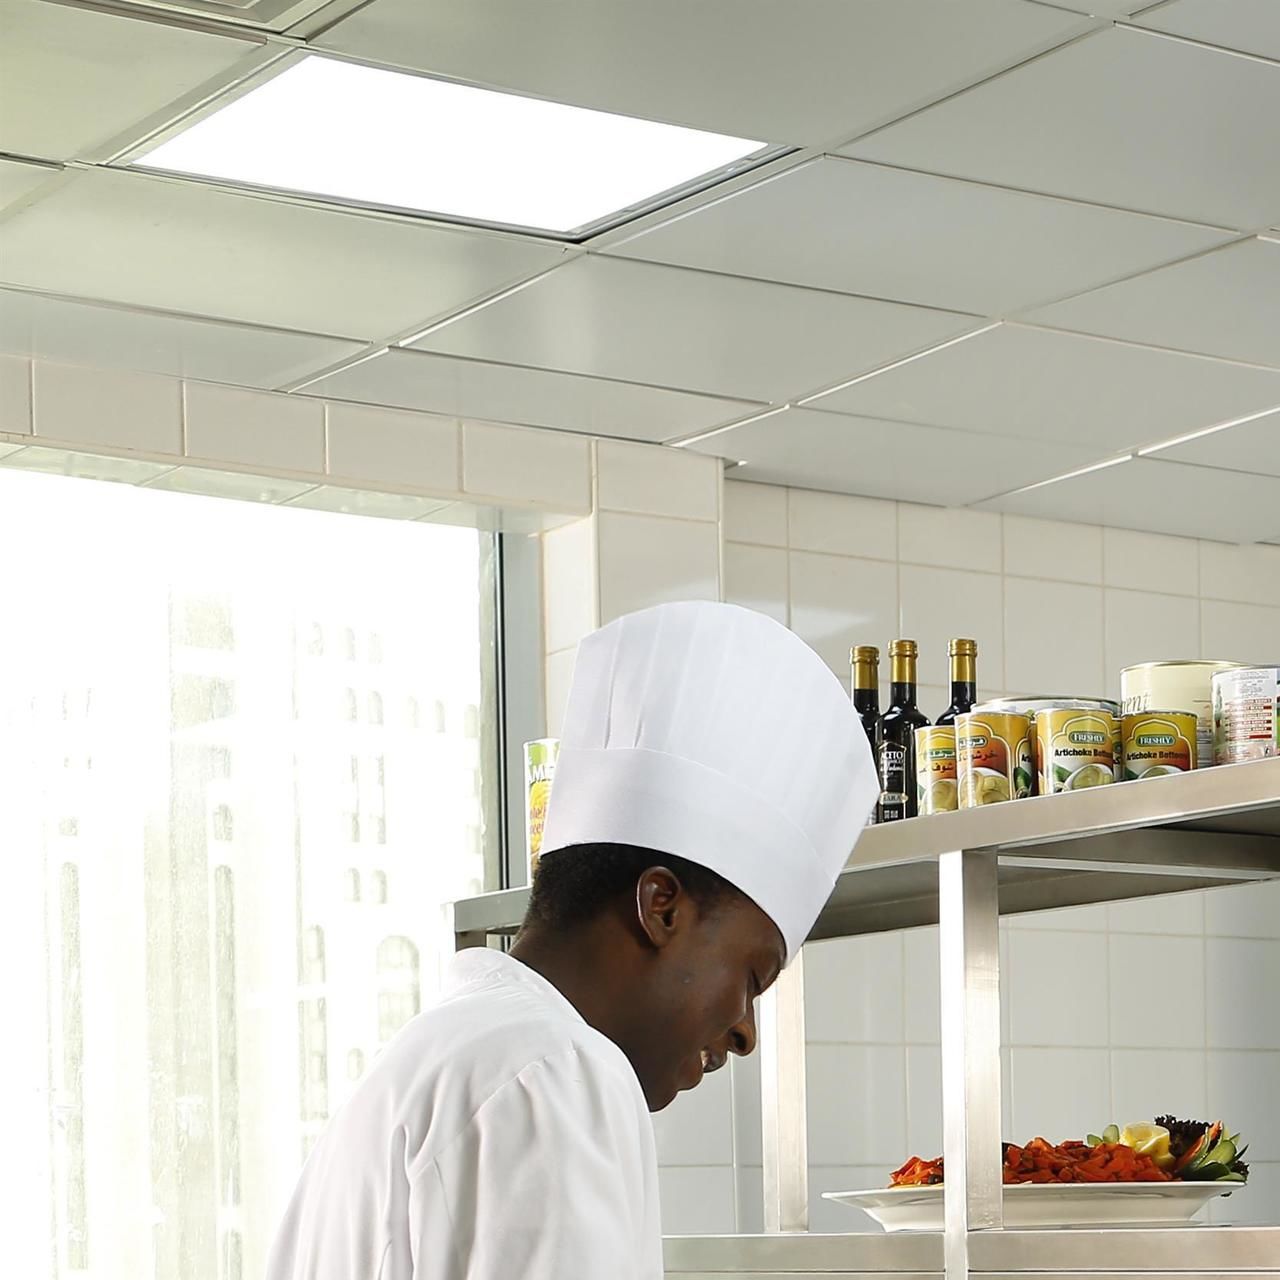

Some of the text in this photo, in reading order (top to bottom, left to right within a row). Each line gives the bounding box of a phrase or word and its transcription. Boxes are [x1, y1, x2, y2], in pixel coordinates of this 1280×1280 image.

[1073, 733, 1104, 743] FRESHLY
[1140, 737, 1171, 745] FRESHLY
[1054, 749, 1092, 757] Artichoke
[1127, 752, 1158, 761] Artichoke
